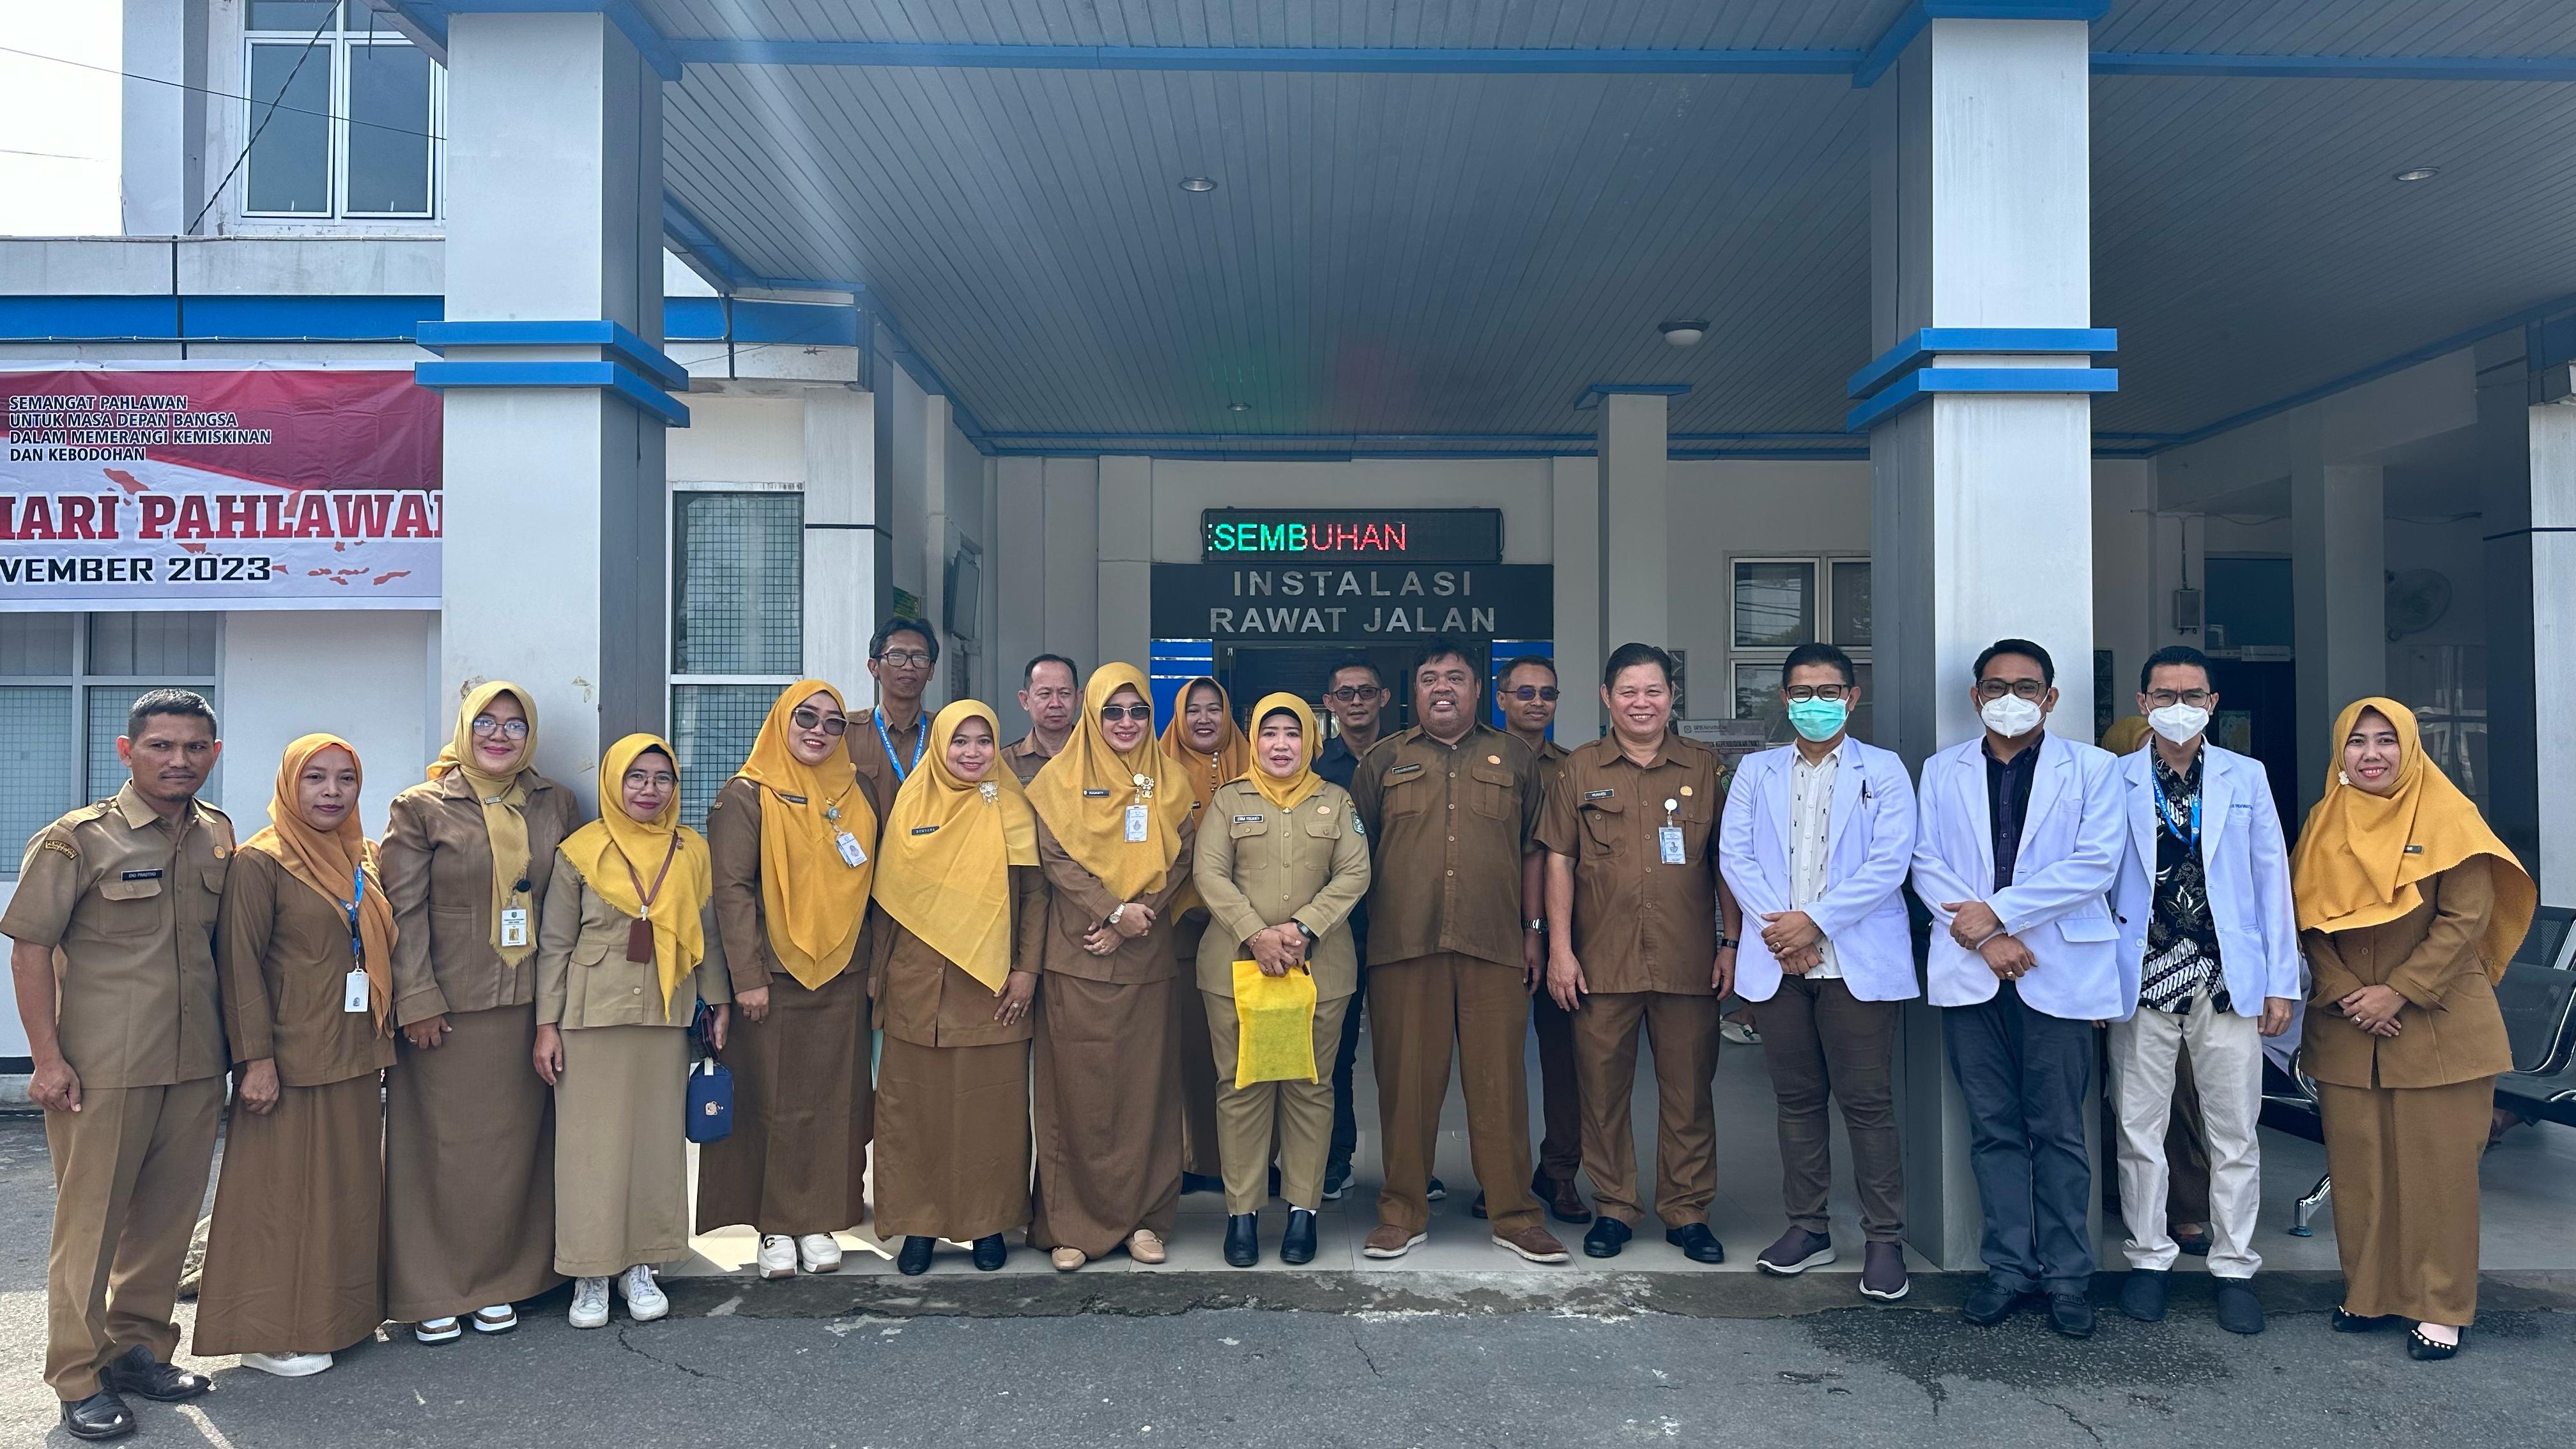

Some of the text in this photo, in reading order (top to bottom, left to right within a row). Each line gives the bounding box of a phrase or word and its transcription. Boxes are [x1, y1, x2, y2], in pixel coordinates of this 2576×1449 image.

[10, 396, 187, 410] SEMANGAT PAHLAWAN
[10, 413, 237, 427] UNTUK MASA DEPAN BANGSA
[10, 429, 272, 445] DALAM MEMERANGI KEMISKINAN
[10, 447, 145, 461] DAN KEBODOHAN
[139, 494, 442, 539] PAHLAWA
[1208, 524, 1406, 551] SEMBUHAN
[168, 557, 271, 581] 2023
[1234, 571, 1470, 597] INSTALASI
[1211, 607, 1495, 633] RAWAT JALAN
